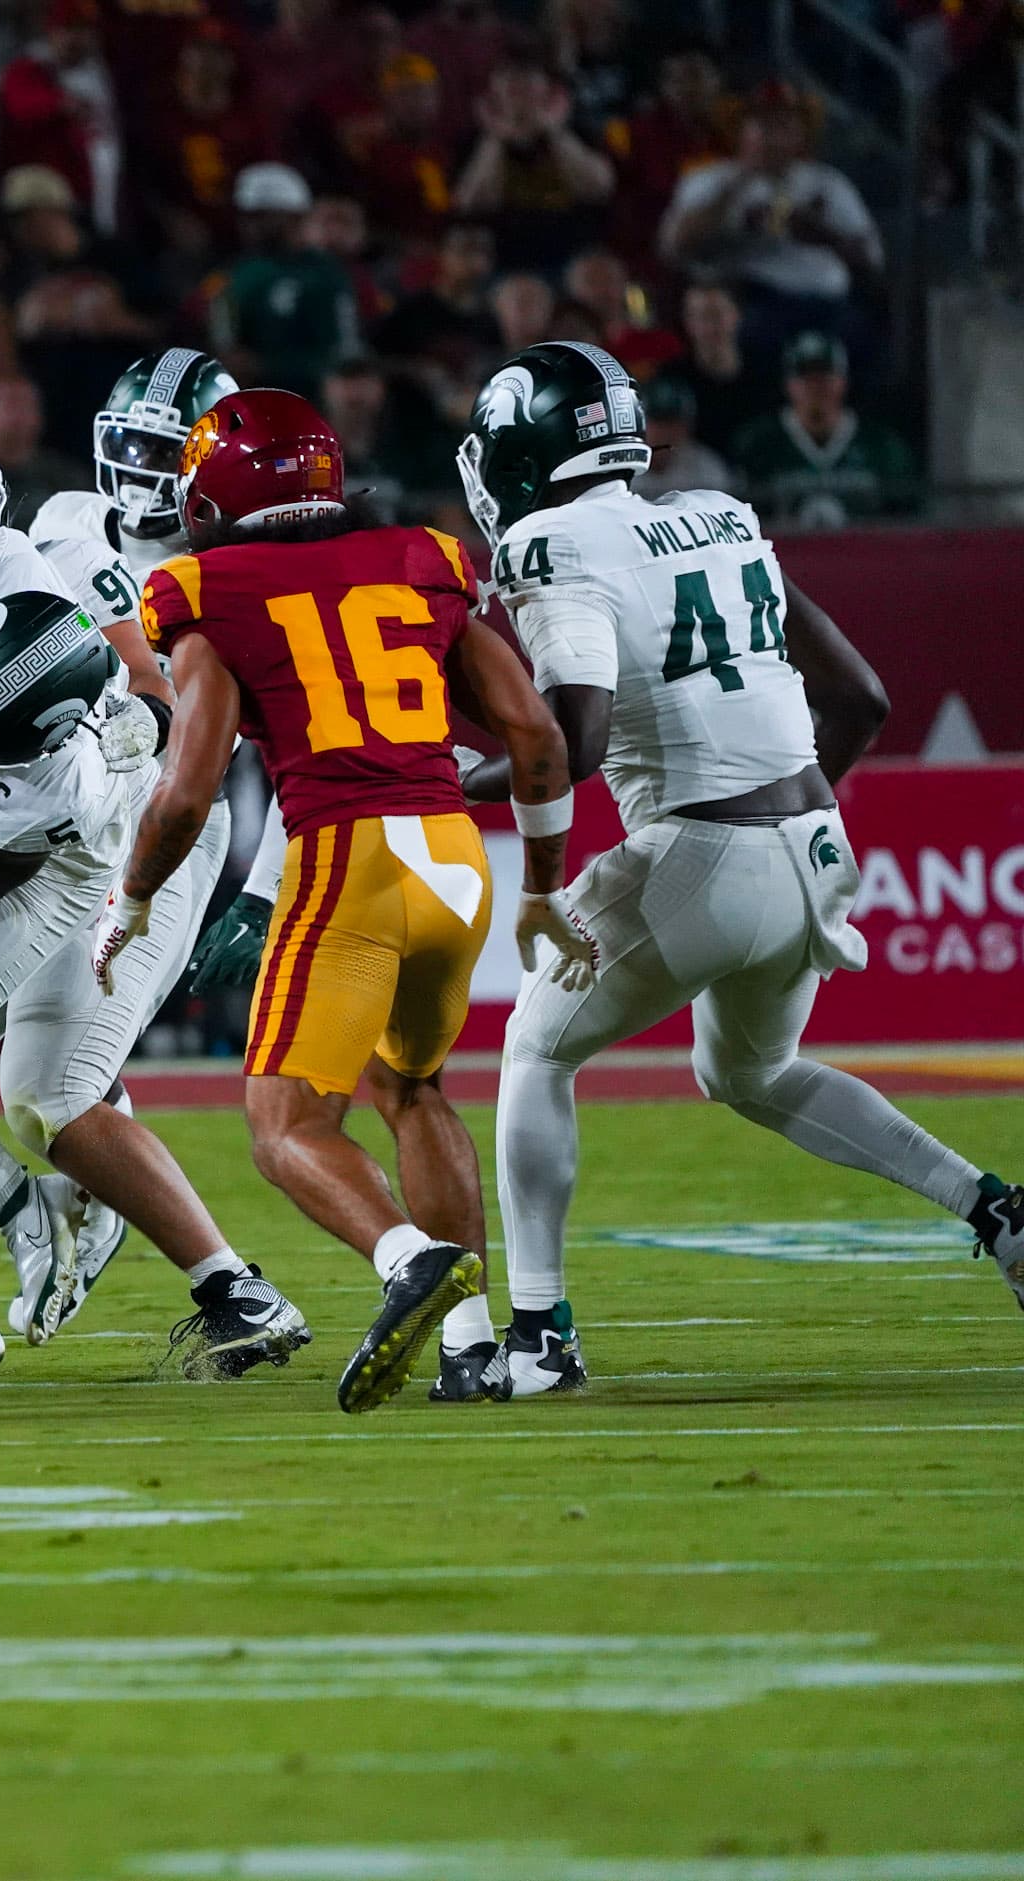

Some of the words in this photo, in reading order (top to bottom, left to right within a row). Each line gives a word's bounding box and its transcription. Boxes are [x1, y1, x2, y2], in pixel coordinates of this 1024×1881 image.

[633, 511, 753, 557] WILLIAMS
[495, 537, 554, 593] 44
[662, 558, 788, 692] 44
[265, 584, 449, 753] 16
[95, 926, 126, 985] TROJANS
